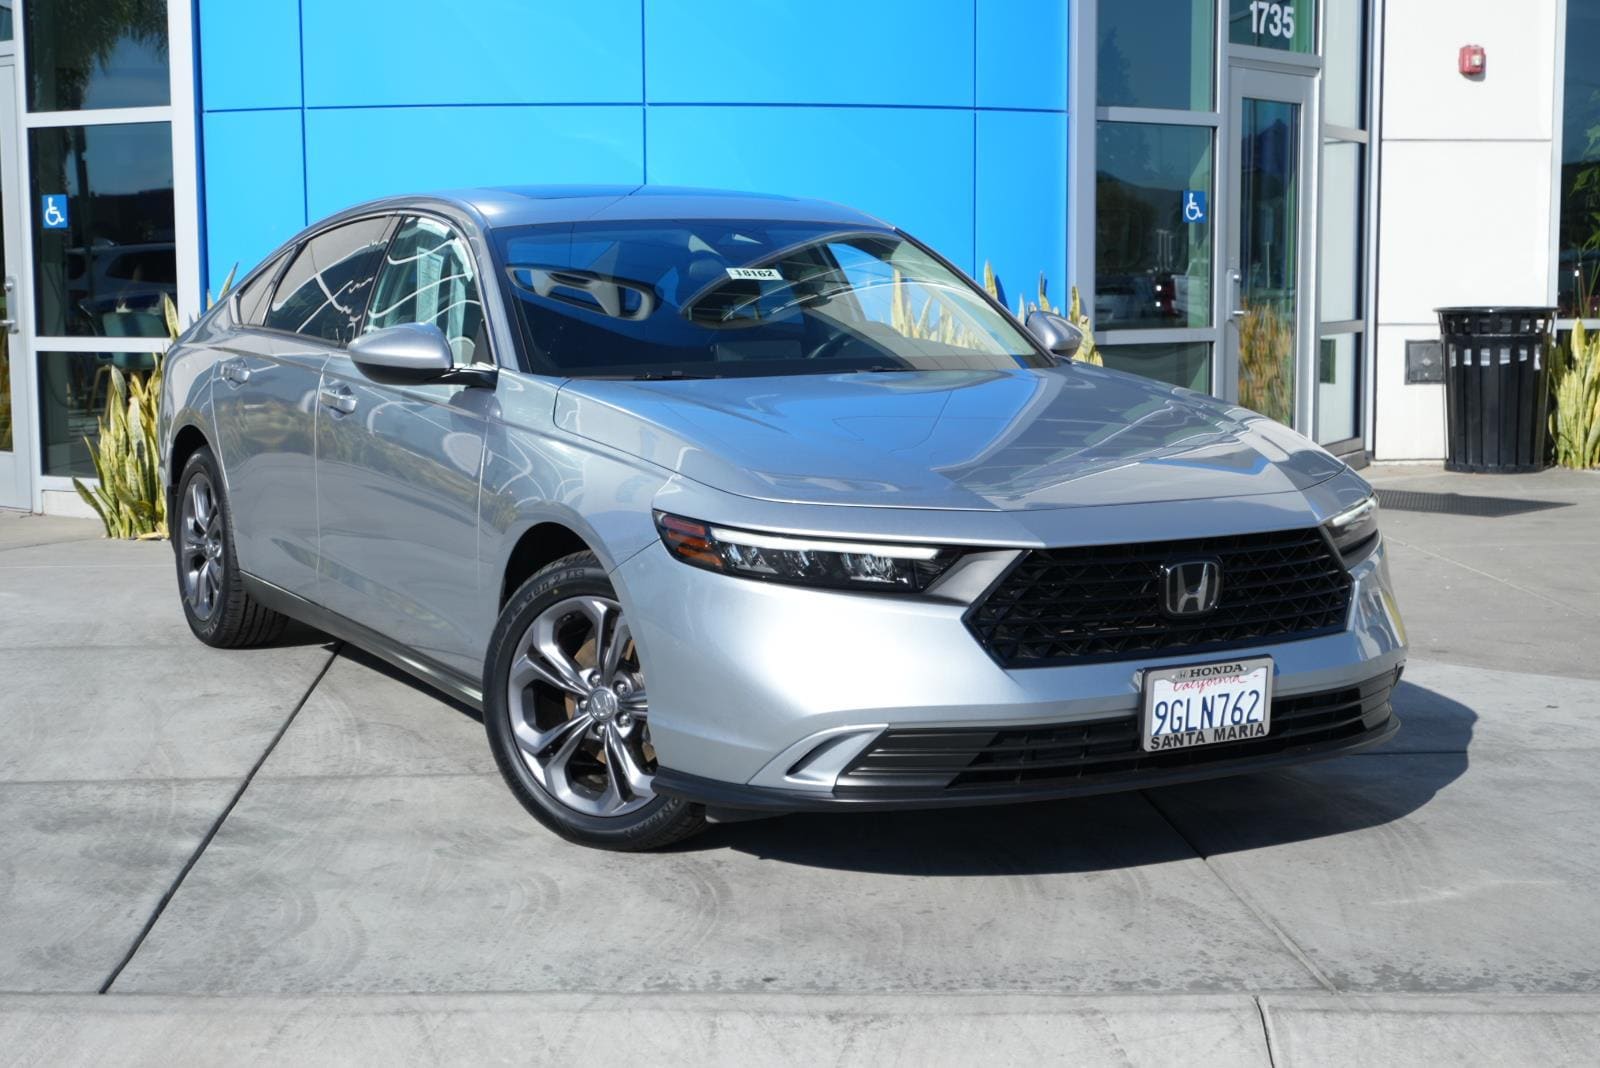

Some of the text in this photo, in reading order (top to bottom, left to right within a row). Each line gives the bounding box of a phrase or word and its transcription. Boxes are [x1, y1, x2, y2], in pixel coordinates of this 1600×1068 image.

[1249, 0, 1295, 39] 1735
[1189, 663, 1244, 679] HONDA
[1152, 689, 1260, 736] 9GLN762
[1150, 722, 1266, 750] SANTA MARIA
